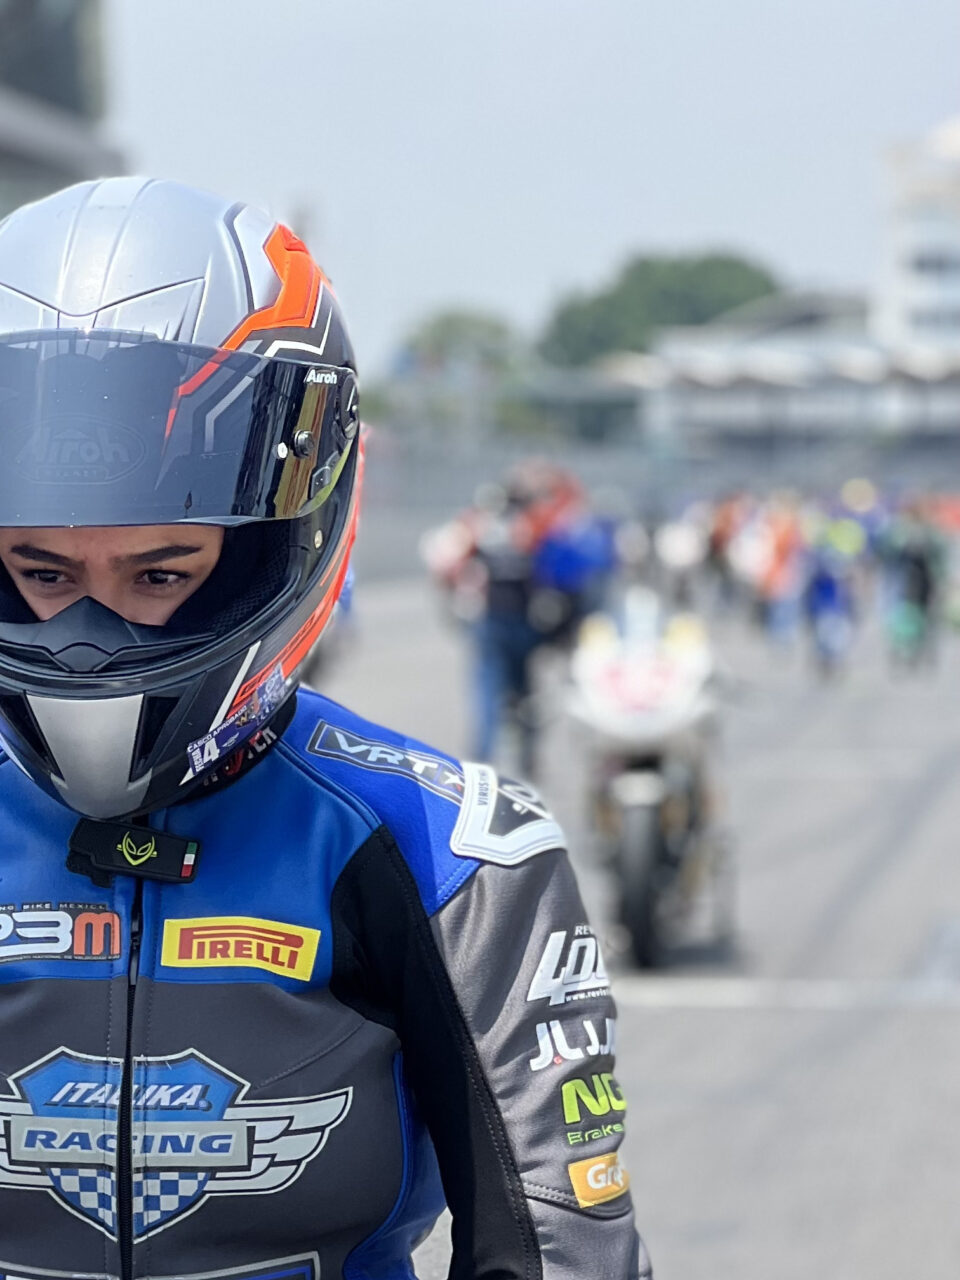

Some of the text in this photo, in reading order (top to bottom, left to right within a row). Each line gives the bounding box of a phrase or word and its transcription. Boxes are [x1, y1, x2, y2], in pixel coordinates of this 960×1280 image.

[306, 369, 338, 385] Airoh
[22, 902, 52, 911] BIKE
[177, 925, 305, 970] PIRELLI
[23, 1129, 233, 1154] RACING
